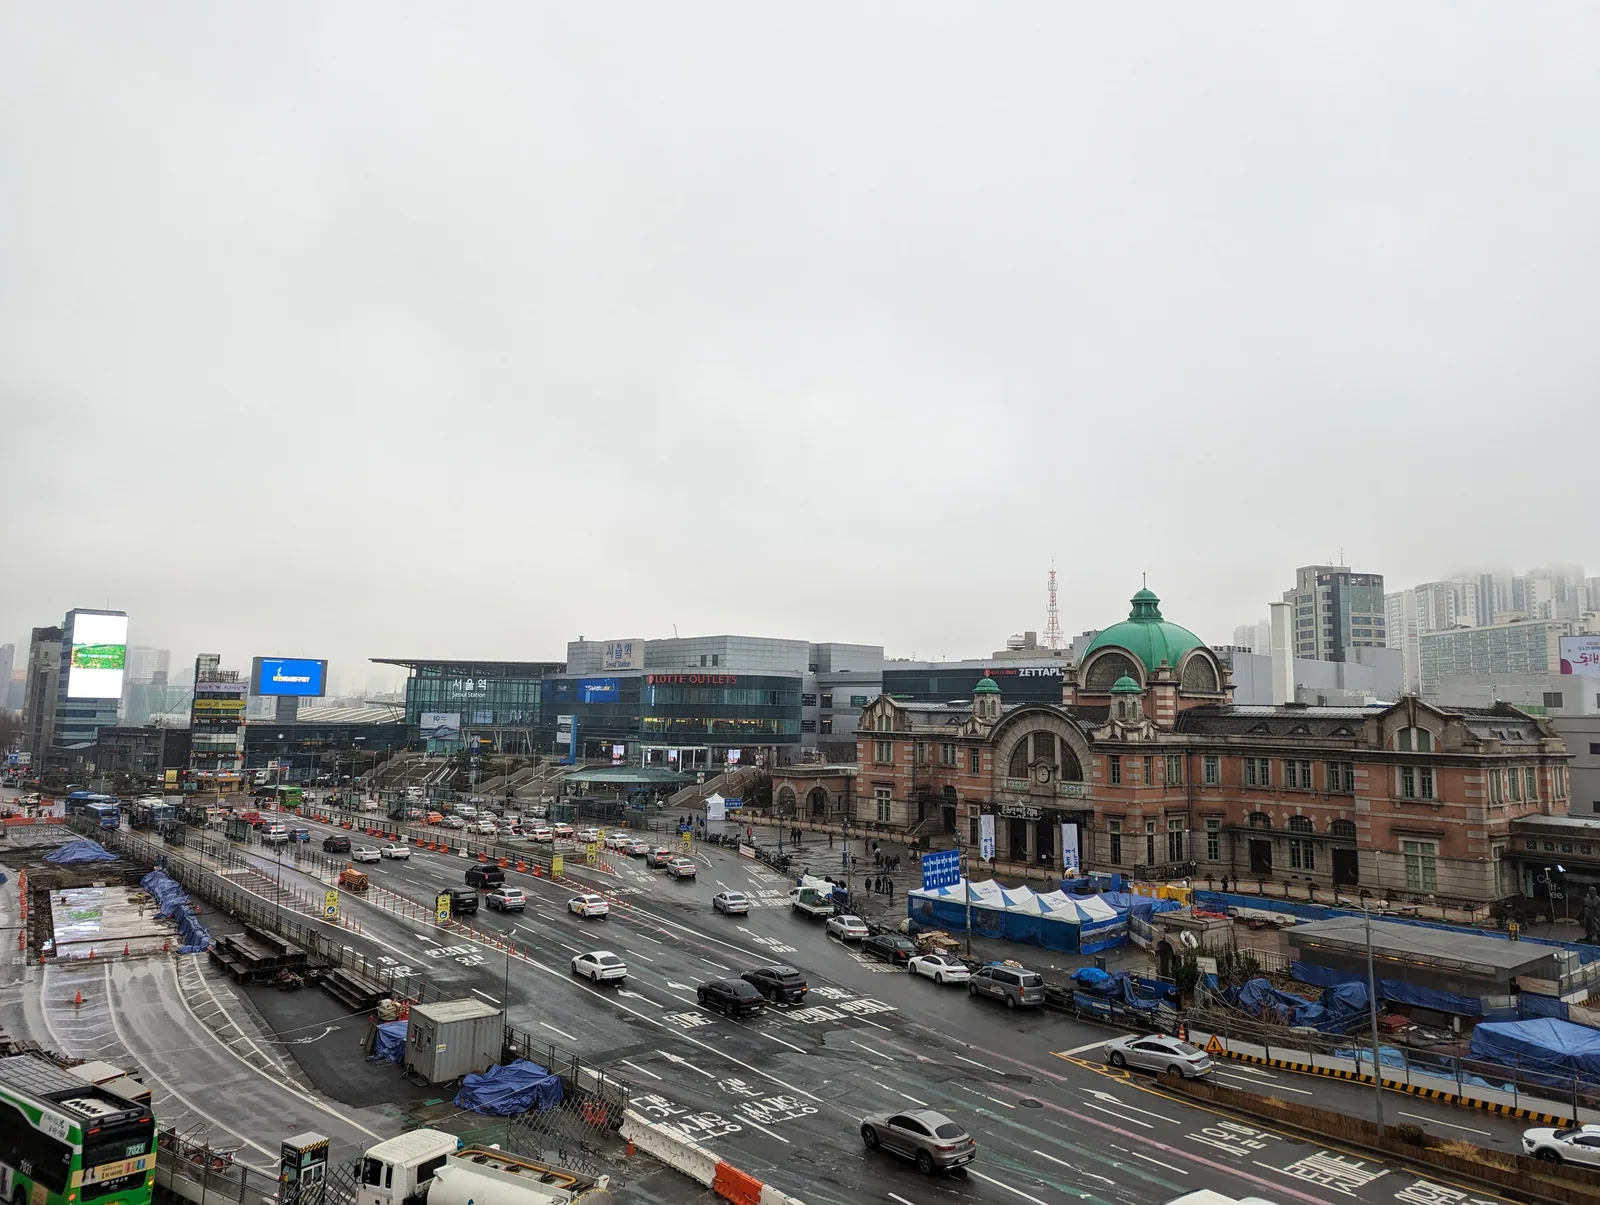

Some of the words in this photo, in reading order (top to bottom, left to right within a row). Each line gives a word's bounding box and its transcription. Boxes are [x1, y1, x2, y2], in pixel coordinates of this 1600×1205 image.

[606, 643, 632, 659] 서울역
[617, 660, 632, 668] Station
[655, 674, 687, 684] LOTTE
[689, 675, 737, 684] OUTLETS
[1019, 667, 1065, 677] ZETTAPL
[452, 678, 487, 691] 서울역
[629, 1093, 688, 1117] 5번
[1183, 1119, 1284, 1157] 서울역
[127, 1144, 145, 1156] 7021
[20, 1159, 33, 1176] 7021
[1282, 1149, 1392, 1193] 롯데마트
